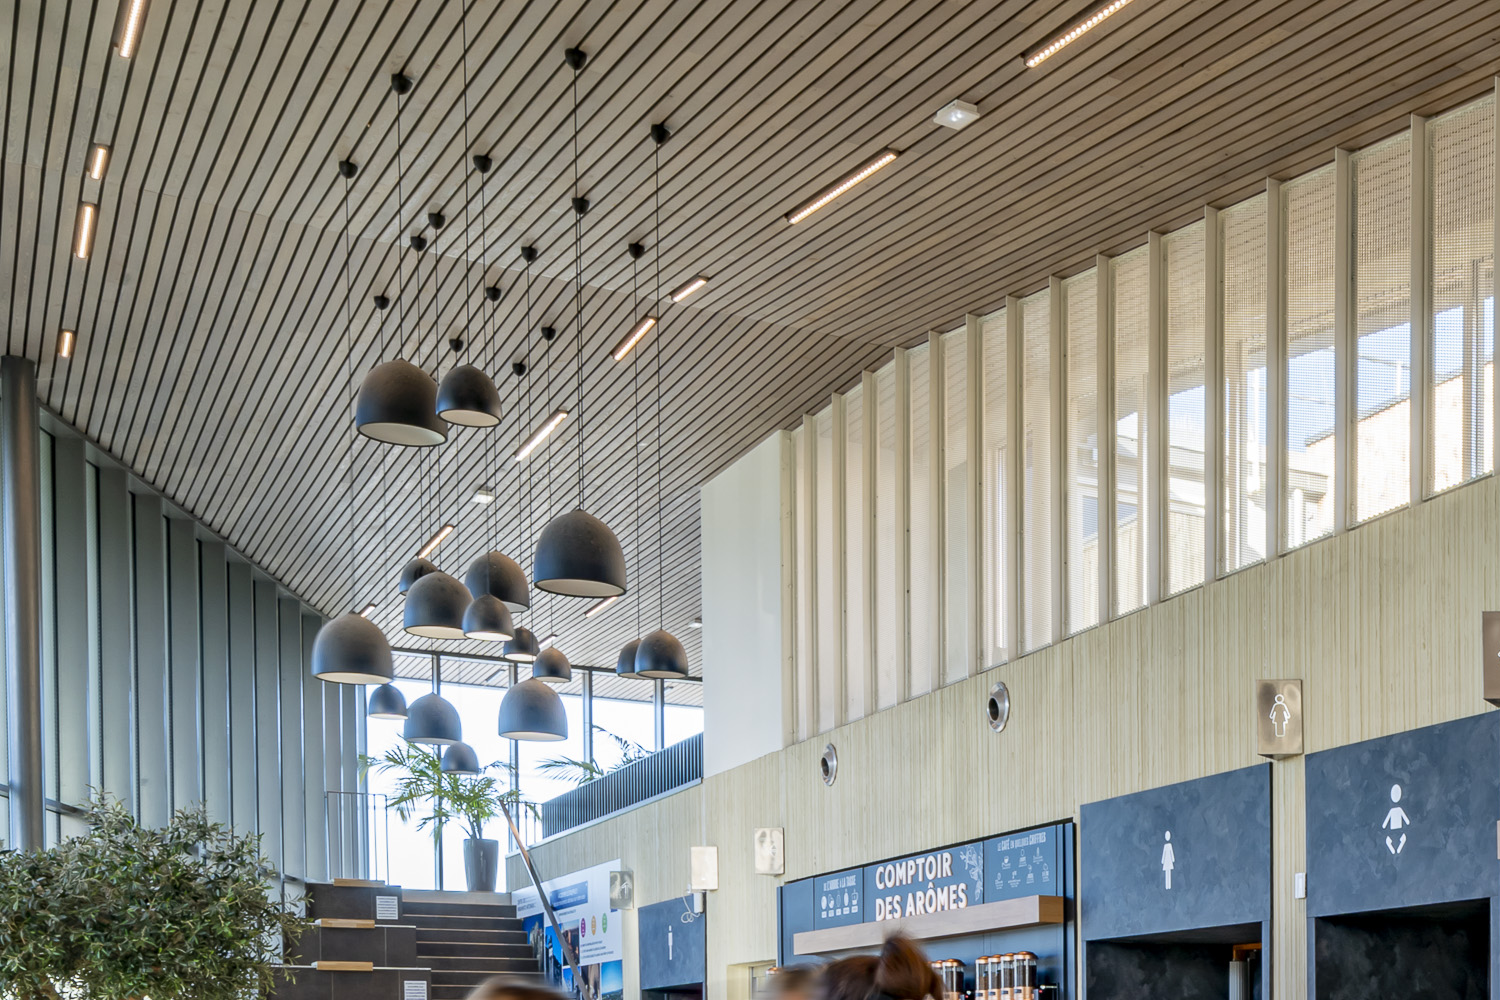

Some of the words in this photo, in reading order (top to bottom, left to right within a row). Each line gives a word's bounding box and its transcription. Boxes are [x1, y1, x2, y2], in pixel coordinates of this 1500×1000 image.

[875, 852, 953, 889] COMPTOIR
[875, 895, 902, 921] DES
[905, 881, 968, 917] ARÔMES
